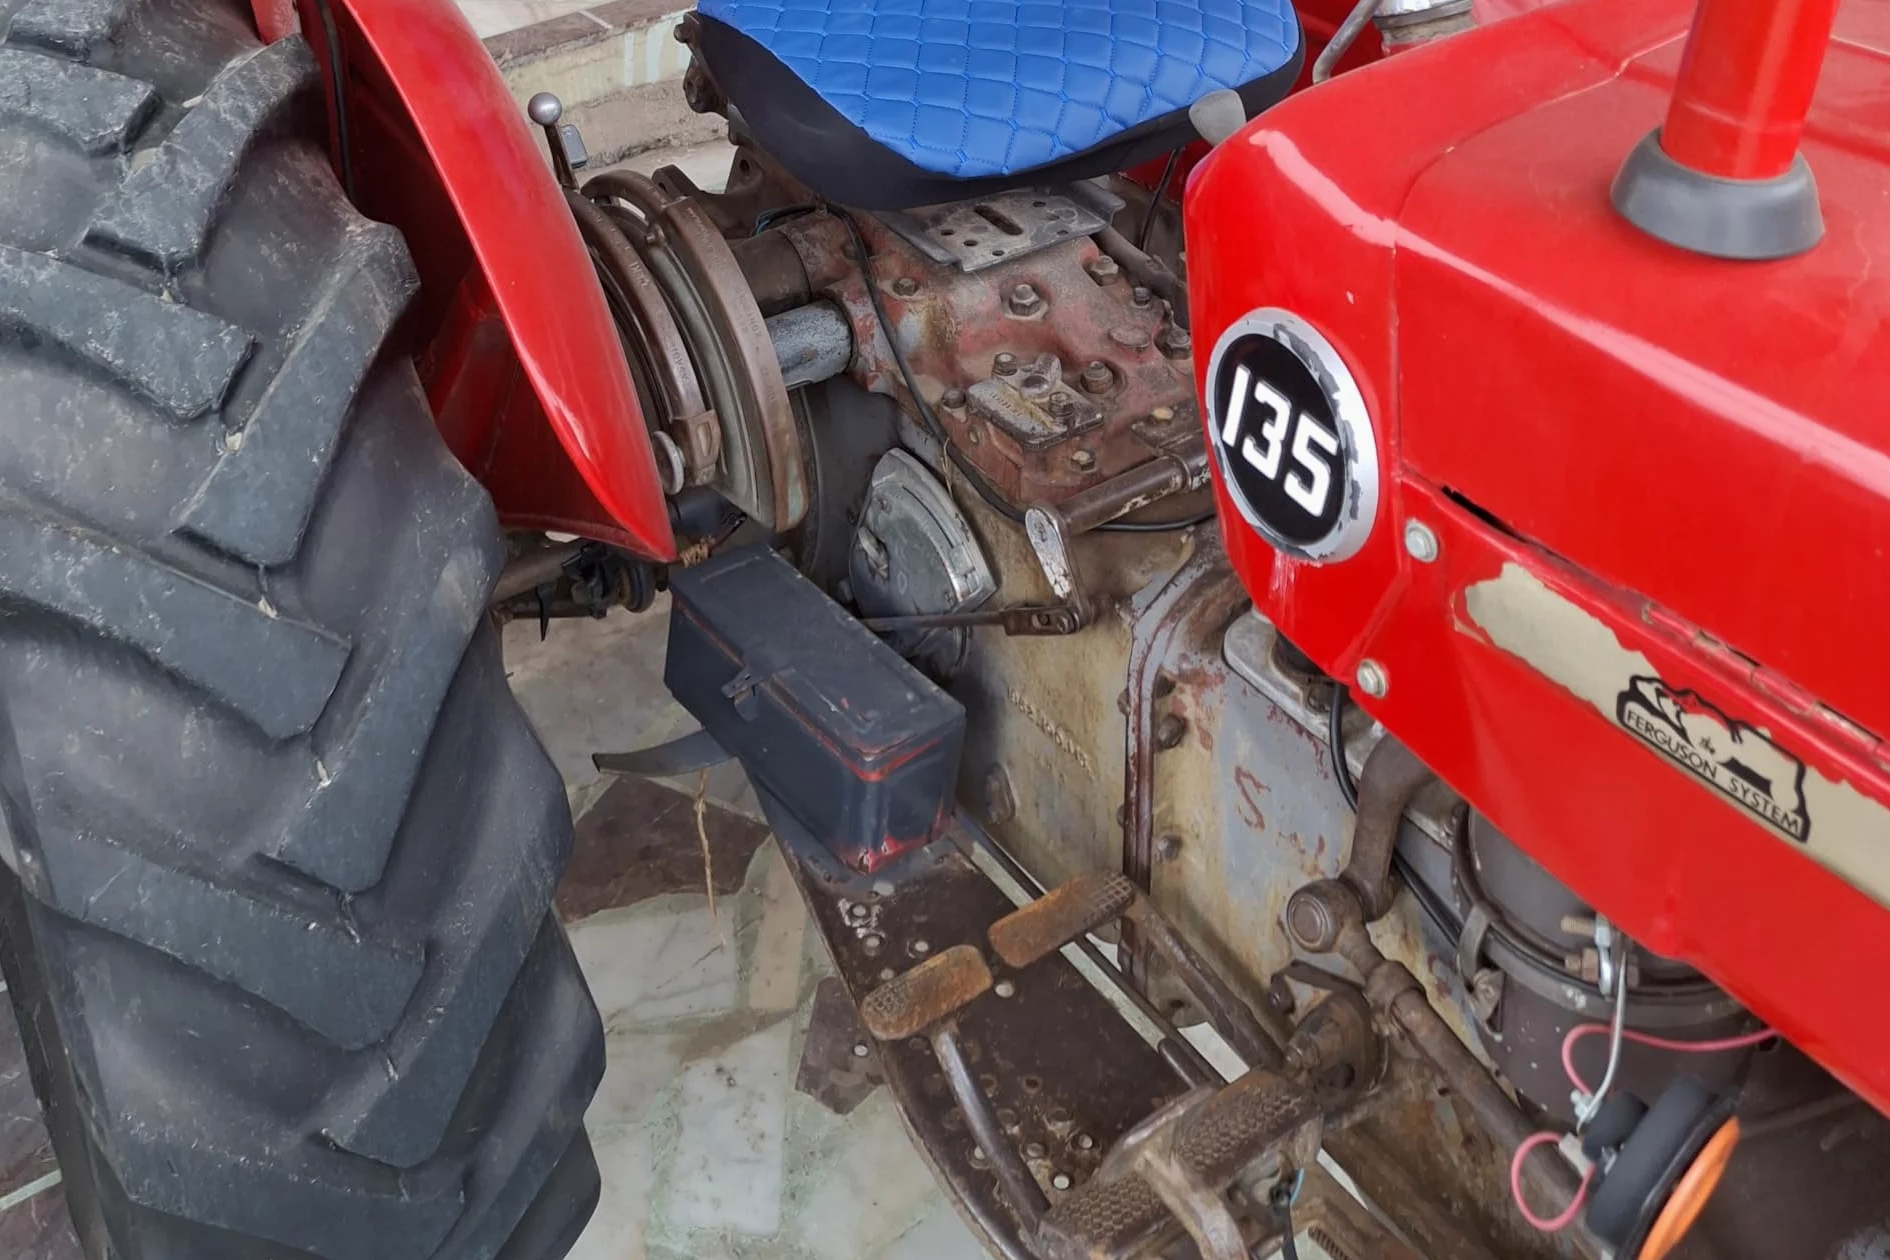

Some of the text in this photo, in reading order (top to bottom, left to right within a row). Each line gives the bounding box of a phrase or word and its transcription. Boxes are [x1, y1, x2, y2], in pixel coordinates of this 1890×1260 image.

[1222, 364, 1339, 517] 135
[1627, 709, 1799, 834] FERGUSON SYSTEM
